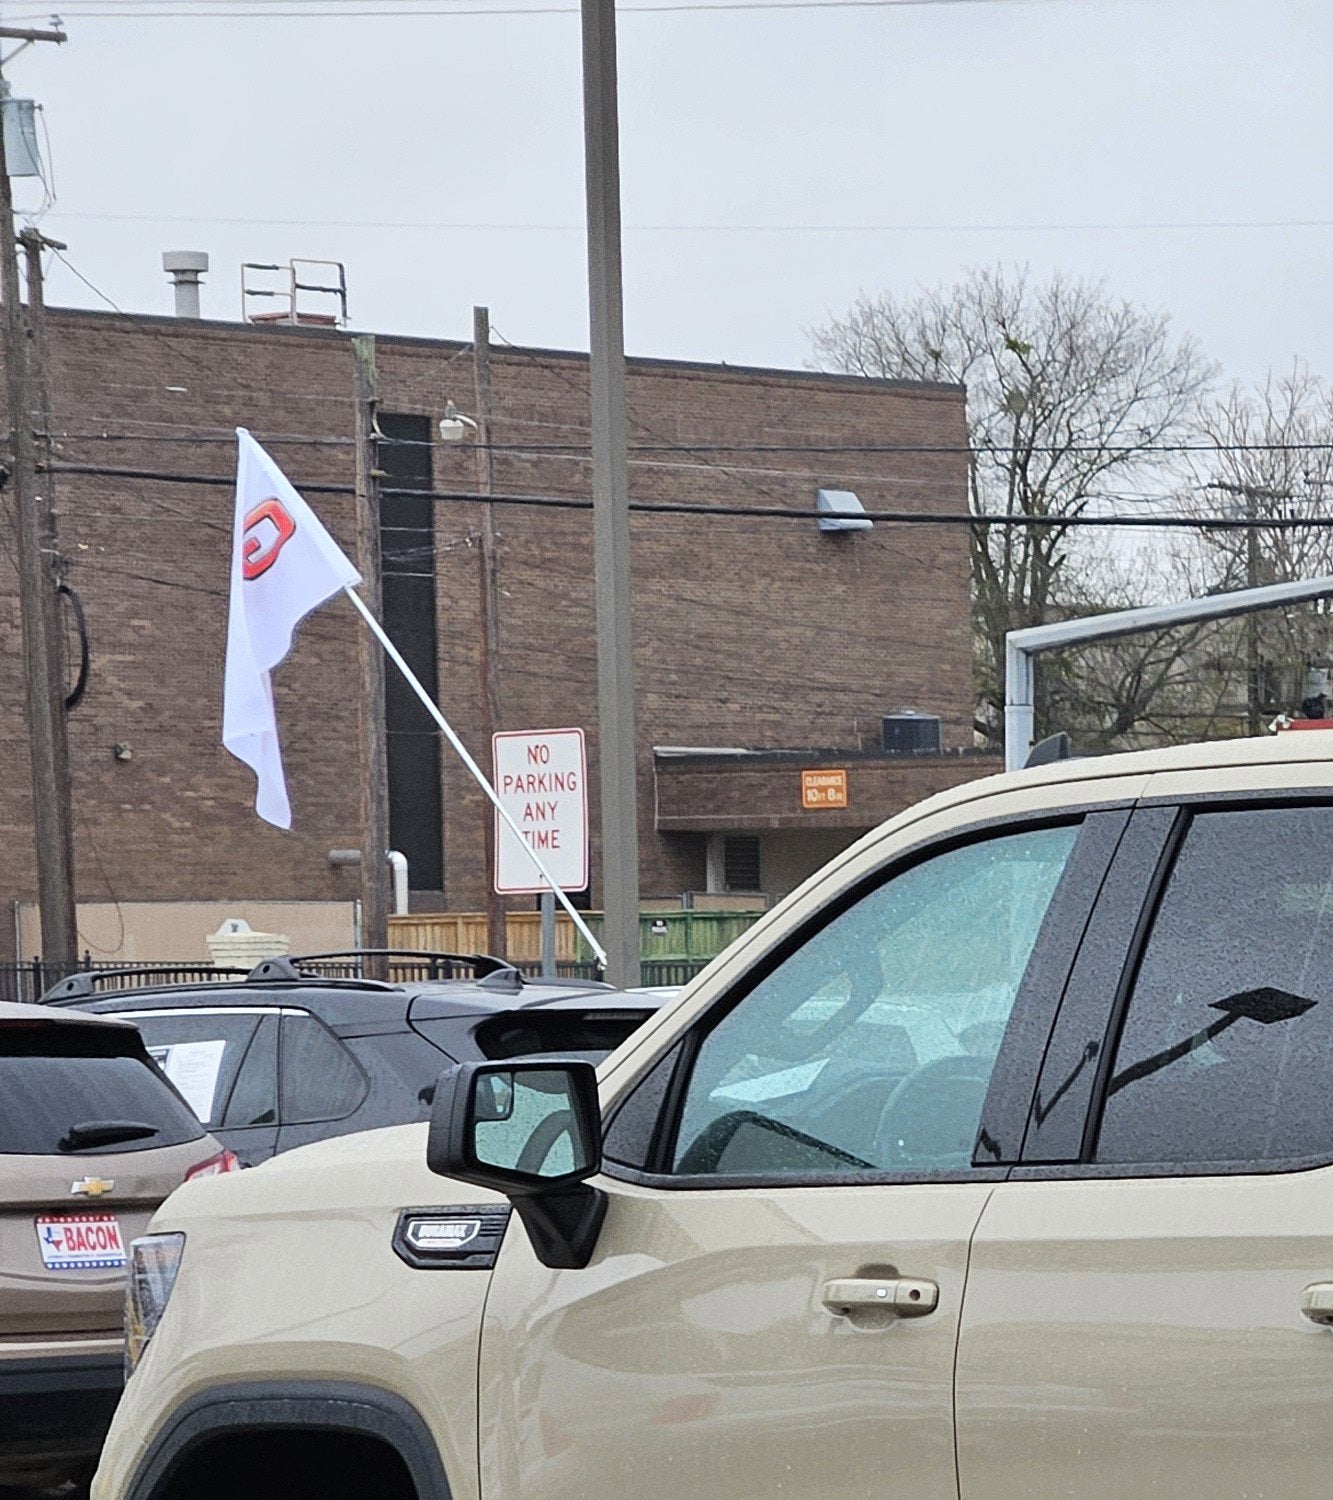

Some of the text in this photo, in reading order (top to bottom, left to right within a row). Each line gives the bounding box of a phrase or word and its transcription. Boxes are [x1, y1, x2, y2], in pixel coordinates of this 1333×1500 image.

[527, 744, 550, 765] NO
[503, 772, 577, 794] PARKING
[523, 801, 558, 822] ANY
[521, 829, 561, 850] TIME
[63, 1225, 120, 1251] BACON
